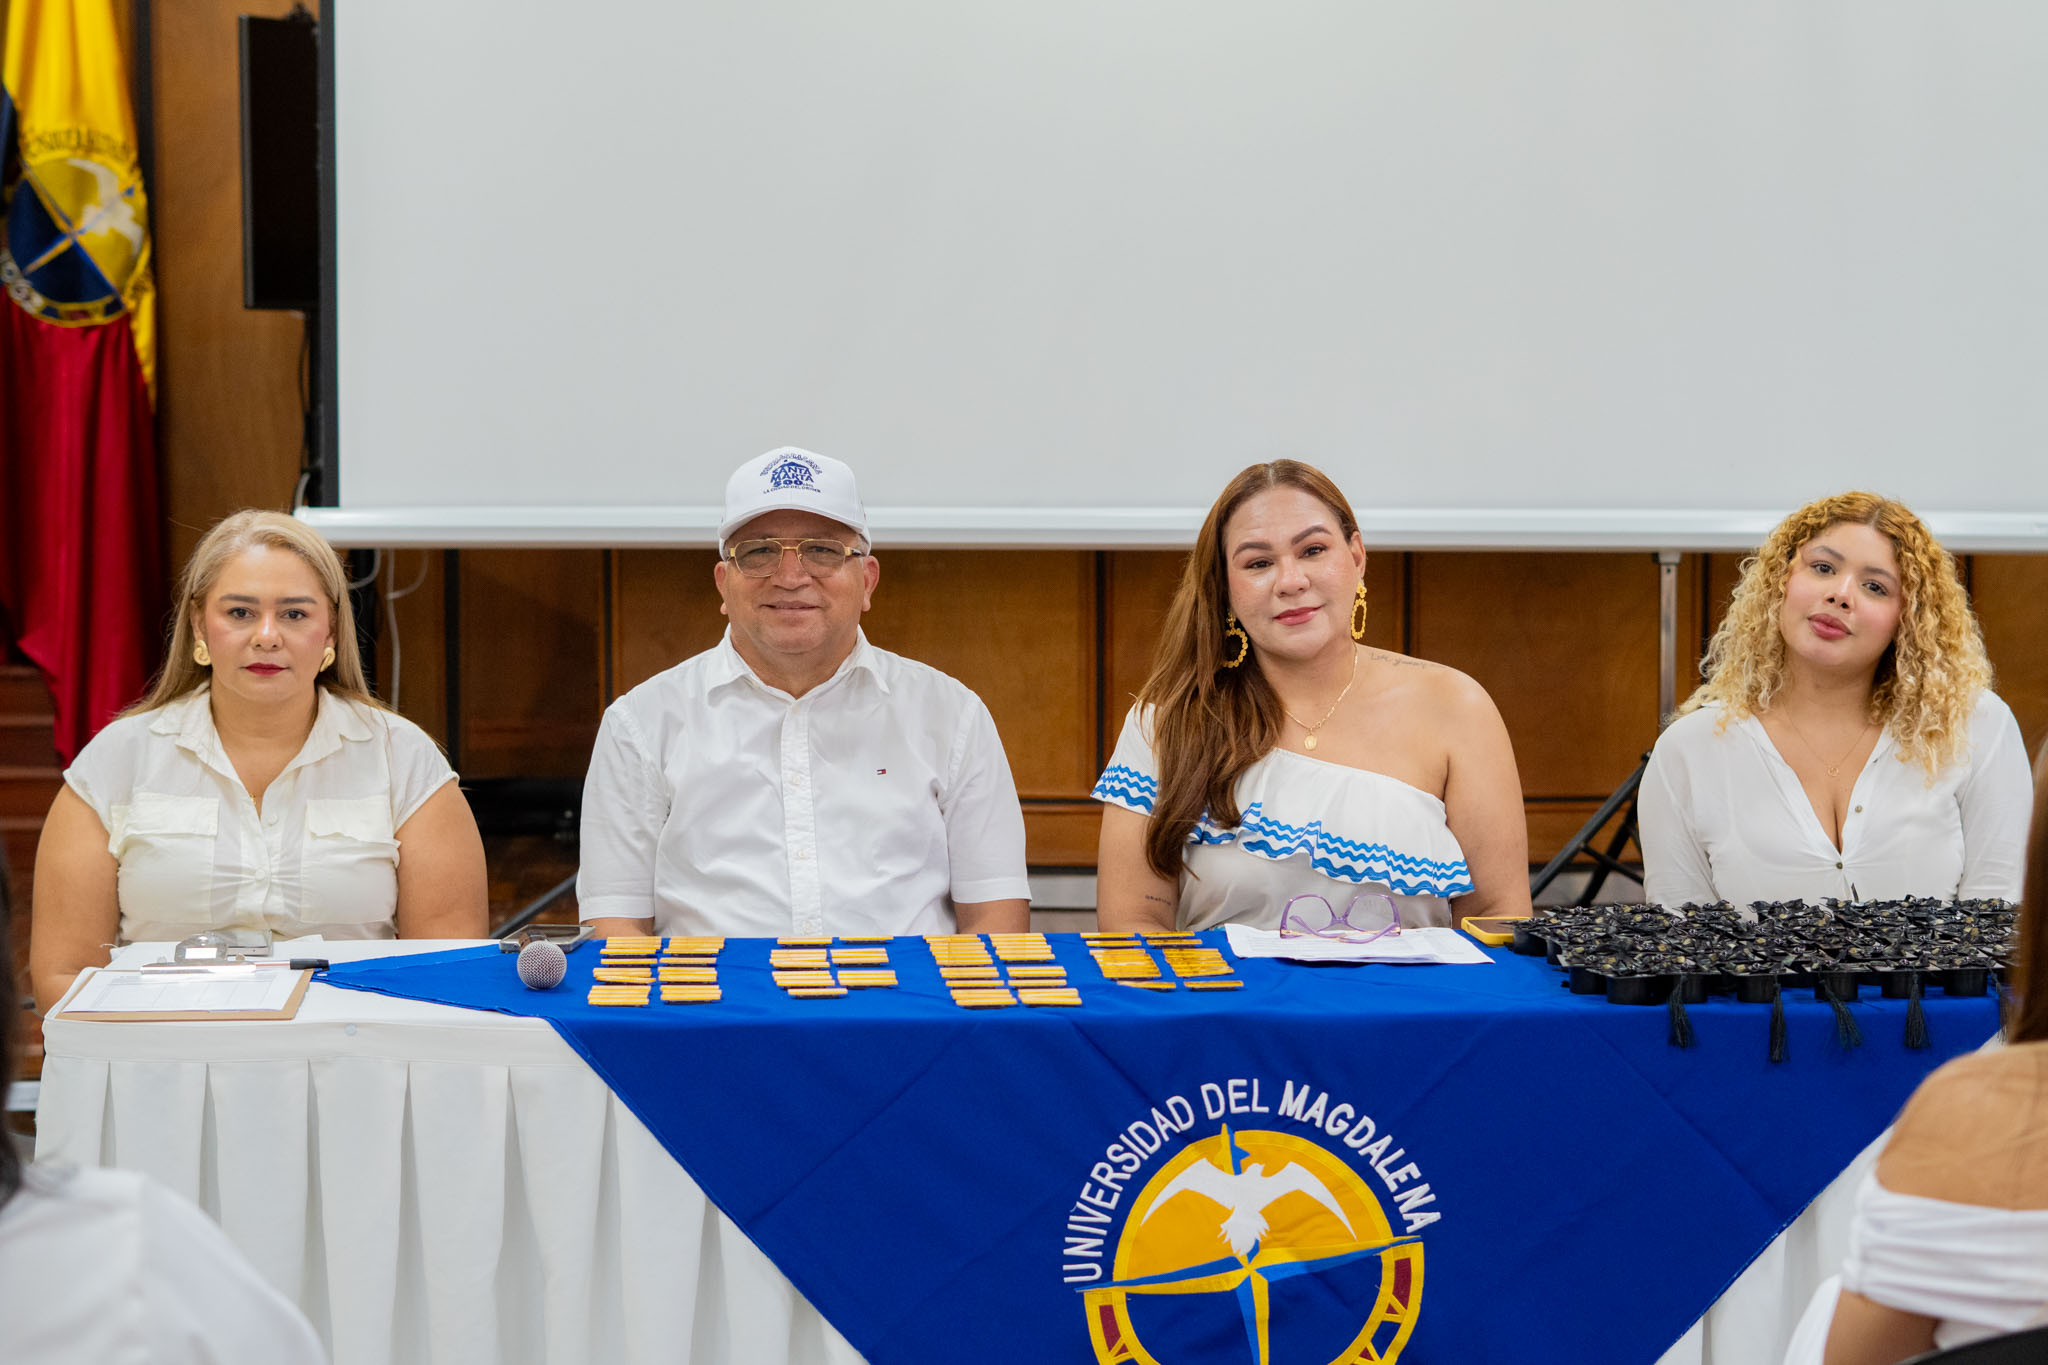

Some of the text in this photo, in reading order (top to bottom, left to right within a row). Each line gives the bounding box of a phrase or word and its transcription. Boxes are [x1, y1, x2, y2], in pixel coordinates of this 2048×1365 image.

[772, 466, 812, 476] SANTA
[770, 473, 814, 483] MARTA
[1063, 1078, 1442, 1283] UNIVERSIDAD DEL MAGDALENA
